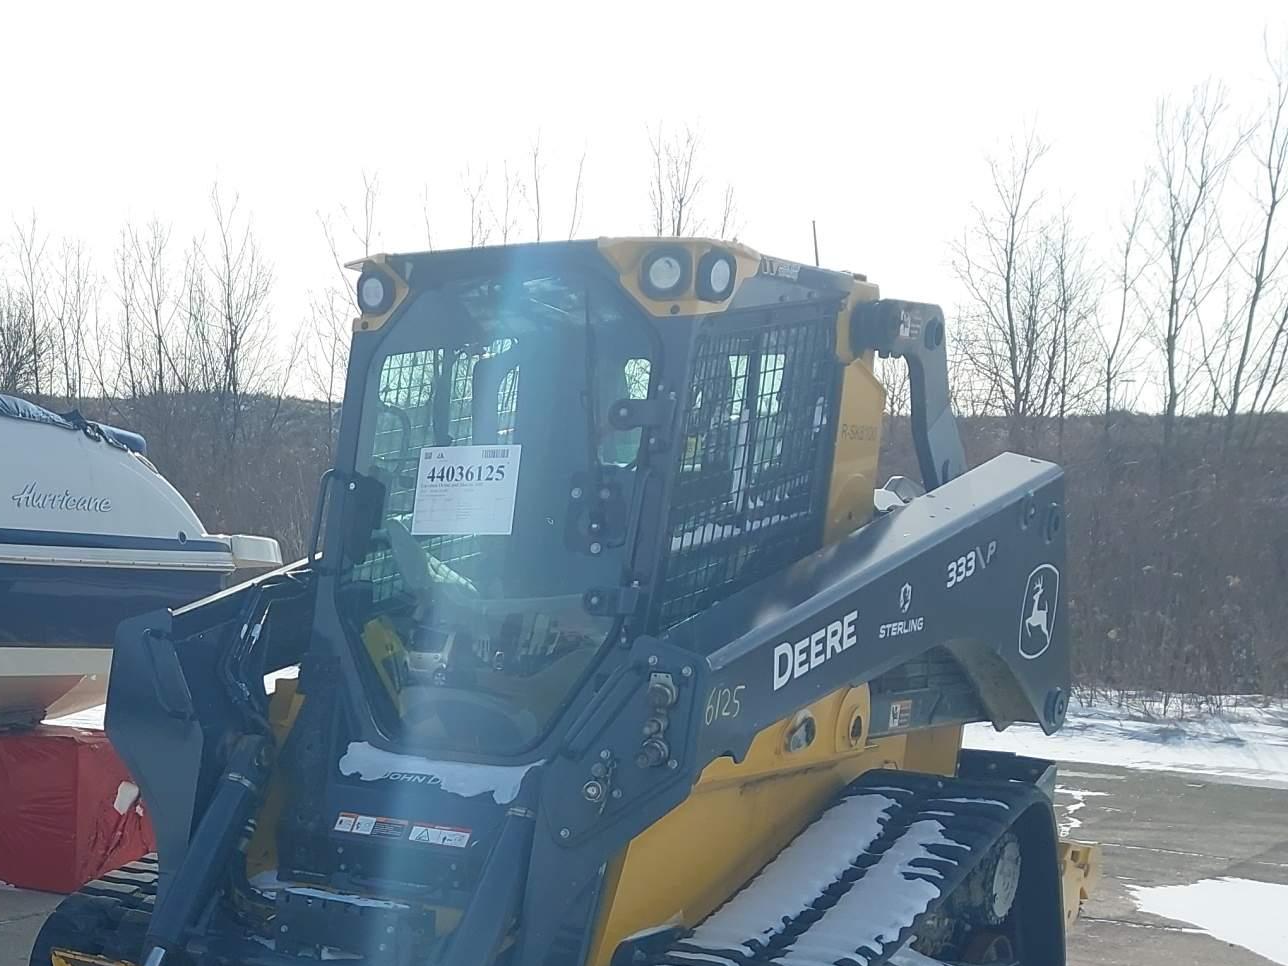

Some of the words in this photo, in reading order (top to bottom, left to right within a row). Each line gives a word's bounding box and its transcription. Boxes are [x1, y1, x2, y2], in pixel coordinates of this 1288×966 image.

[426, 465, 506, 482] 44036125
[12, 480, 113, 513] Hurricane
[878, 616, 925, 639] STERLING
[773, 610, 859, 692] DEERE
[705, 685, 746, 726] 6125
